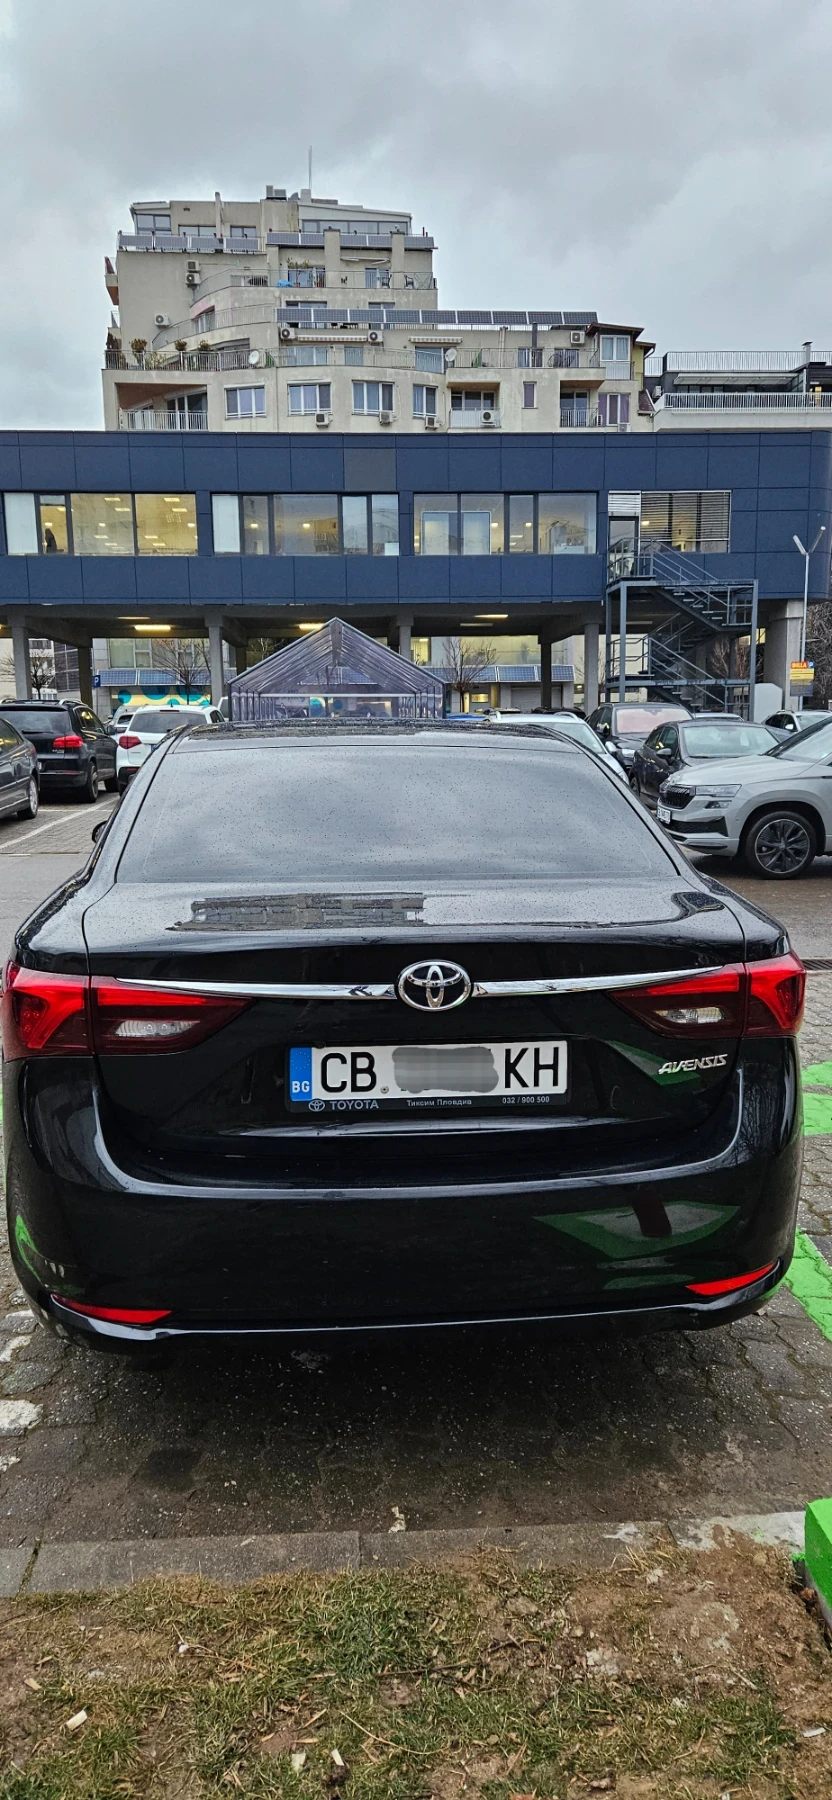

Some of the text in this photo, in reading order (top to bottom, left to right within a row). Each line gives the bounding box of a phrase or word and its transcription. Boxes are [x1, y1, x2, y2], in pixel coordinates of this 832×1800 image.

[292, 1081, 310, 1093] BG
[320, 1051, 377, 1093] CB
[504, 1047, 559, 1088] KH
[658, 1054, 728, 1074] AVENSIS
[330, 1100, 379, 1110] TOYOTA
[521, 1096, 535, 1104] 900
[536, 1095, 550, 1103] 500
